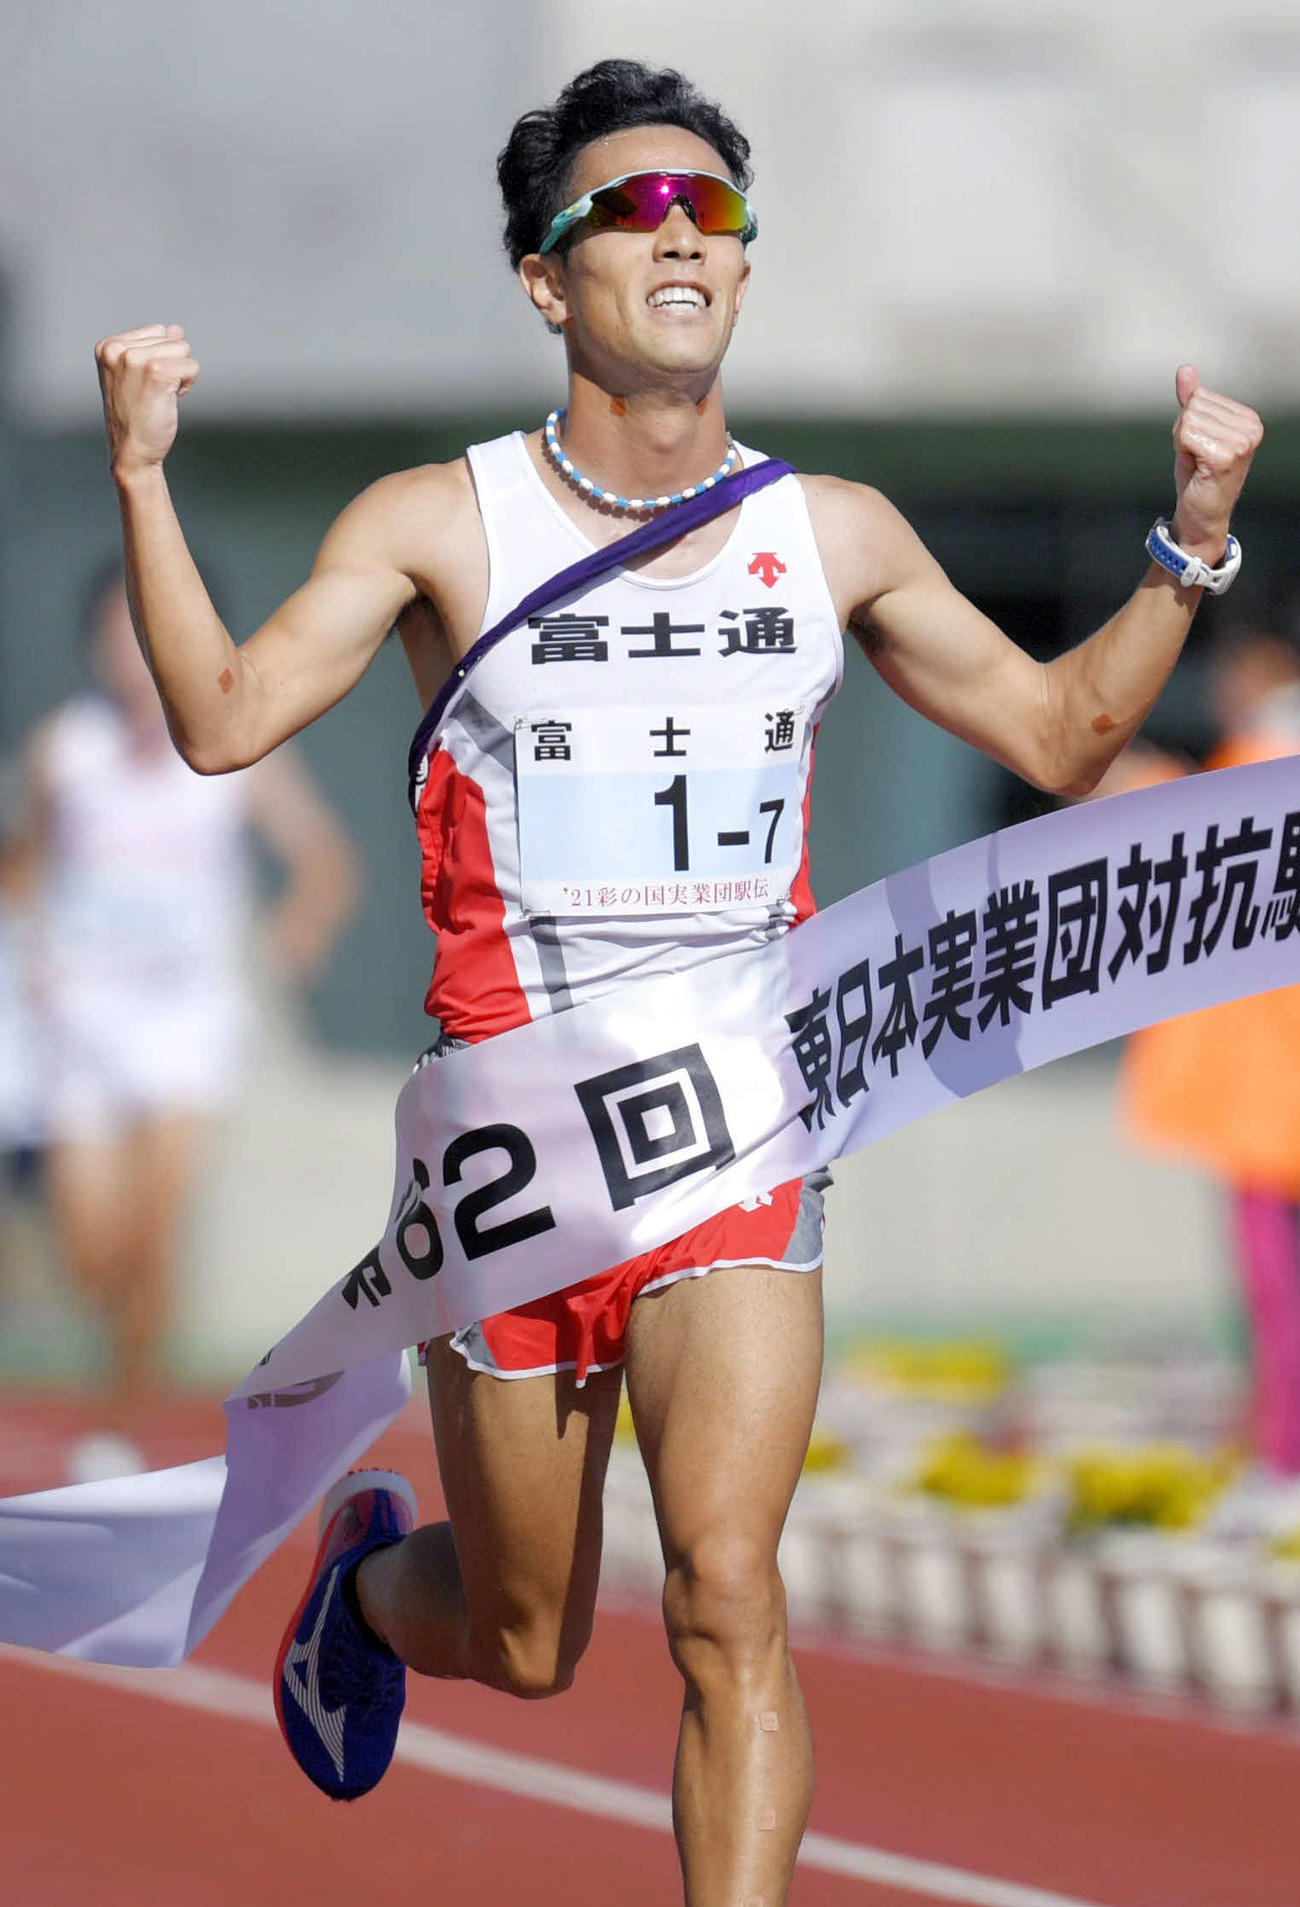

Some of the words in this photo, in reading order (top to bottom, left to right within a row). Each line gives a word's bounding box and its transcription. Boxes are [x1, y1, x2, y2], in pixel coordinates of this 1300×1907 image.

[528, 607, 797, 665] 富士通
[654, 774, 784, 871] 1-7
